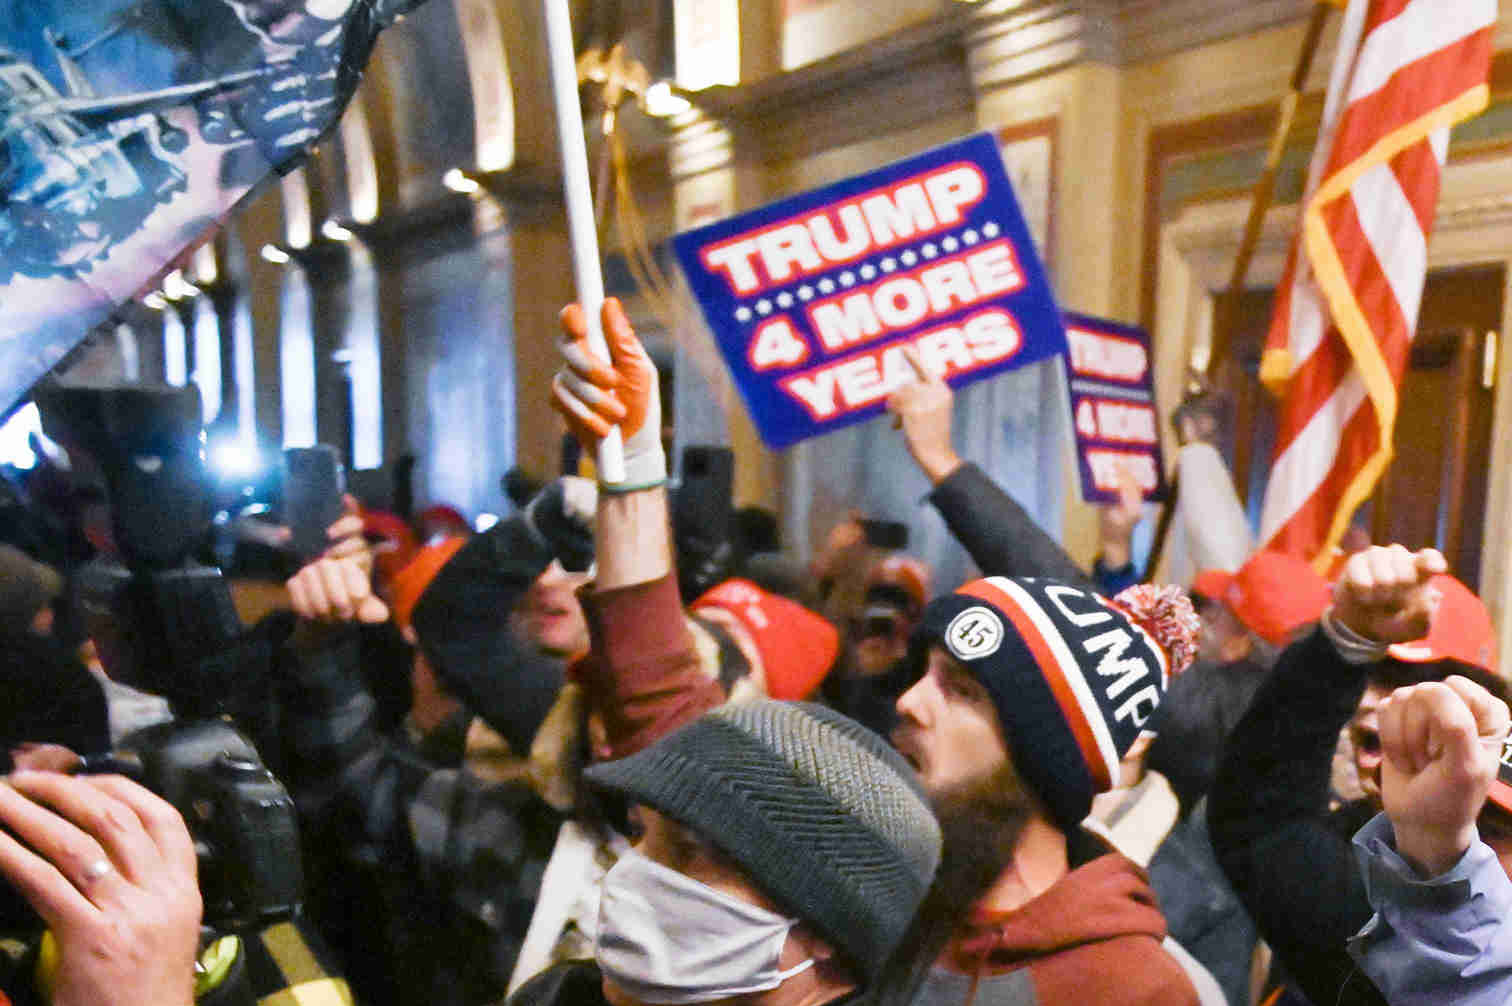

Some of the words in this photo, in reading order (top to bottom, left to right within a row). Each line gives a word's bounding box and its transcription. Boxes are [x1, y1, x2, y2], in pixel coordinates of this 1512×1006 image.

[703, 163, 987, 295] TRUMP
[750, 317, 808, 371] 4
[808, 240, 1025, 352] MORE
[781, 308, 1022, 422] YEARS
[957, 619, 993, 648] 45
[1043, 584, 1161, 729] UMP
